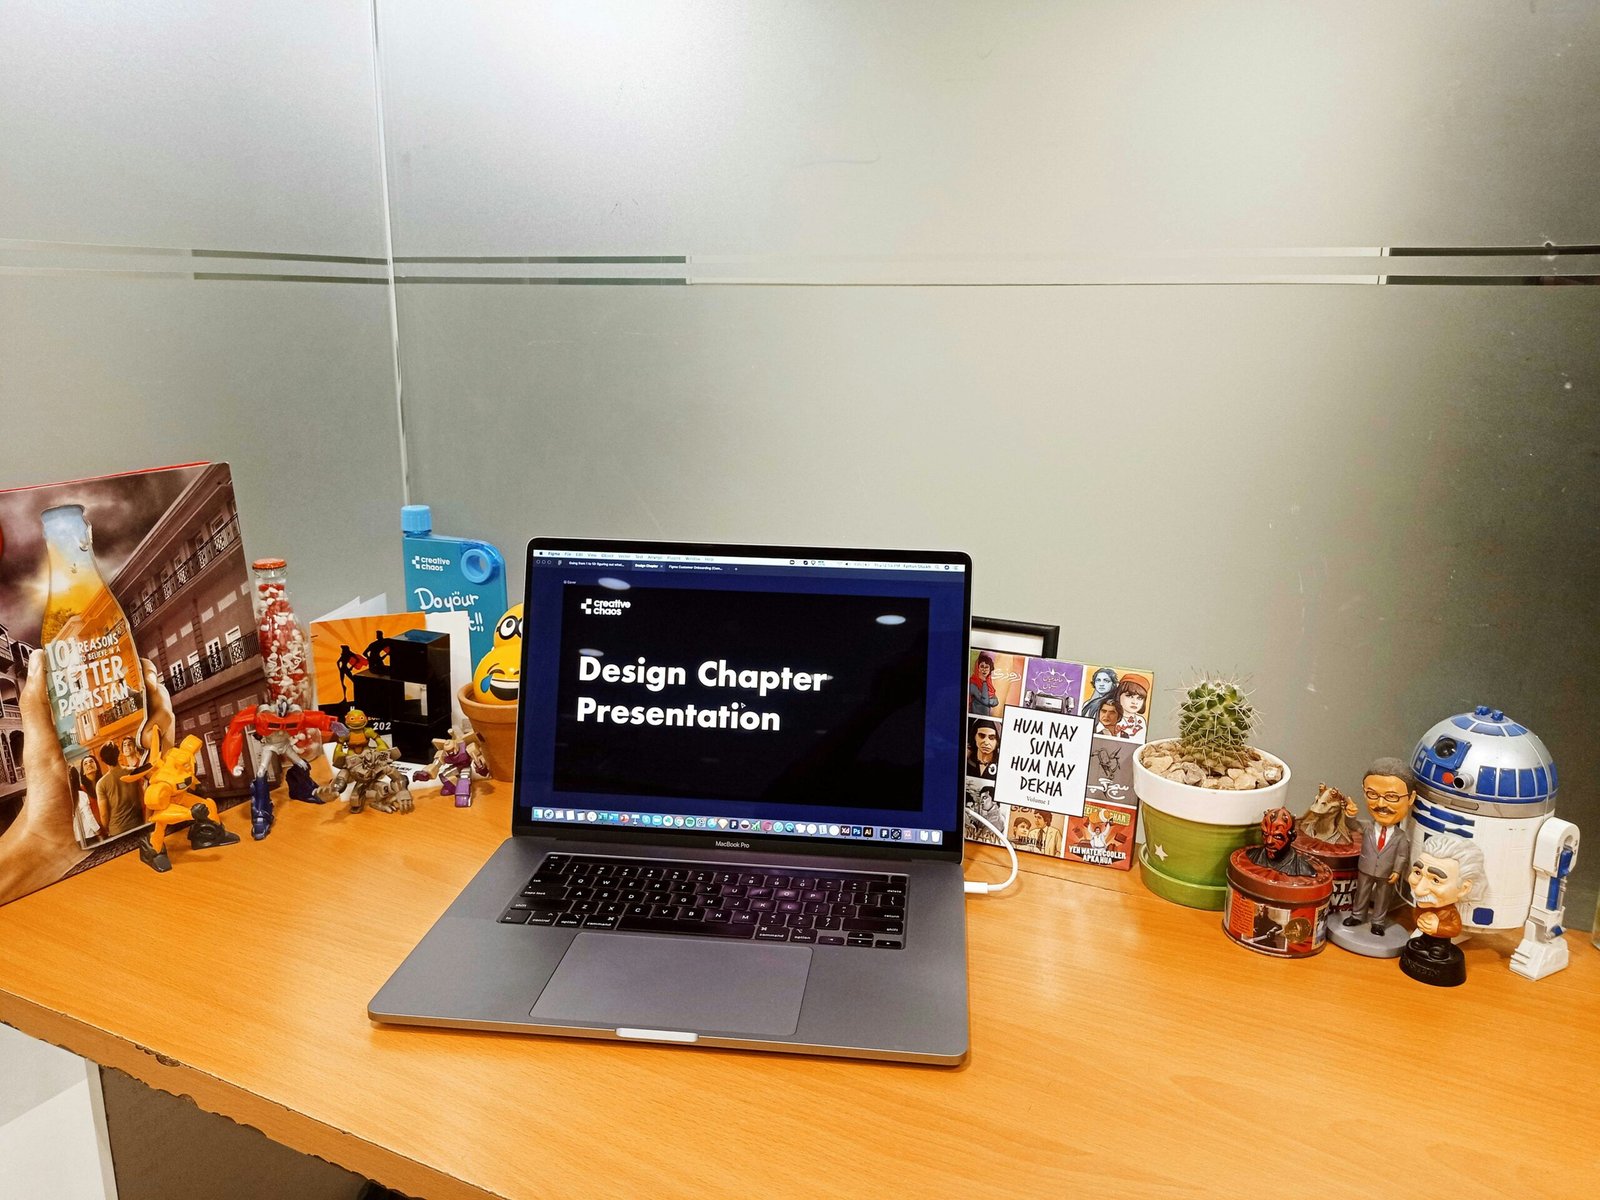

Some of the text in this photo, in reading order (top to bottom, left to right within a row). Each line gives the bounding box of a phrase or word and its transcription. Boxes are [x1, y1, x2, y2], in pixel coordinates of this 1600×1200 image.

[420, 556, 450, 565] creative
[414, 588, 479, 612] Do your
[593, 599, 631, 609] creative
[593, 607, 622, 616] chaos
[45, 632, 118, 671] 101 REASONS
[52, 656, 125, 697] BETTER
[579, 656, 828, 697] Design Chapter
[58, 680, 128, 717] PAKISTAN
[577, 696, 780, 731] Presentation
[373, 722, 391, 730] 202
[1013, 718, 1078, 742] HUM NAY
[1030, 737, 1064, 758] SUNA
[1011, 756, 1075, 780] HUM NAY
[1020, 776, 1062, 797] DEKHA
[1026, 796, 1046, 805] Volume
[1068, 845, 1126, 859] YEH WATER COOLER
[1332, 880, 1357, 892] STA
[1331, 893, 1352, 906] WA
